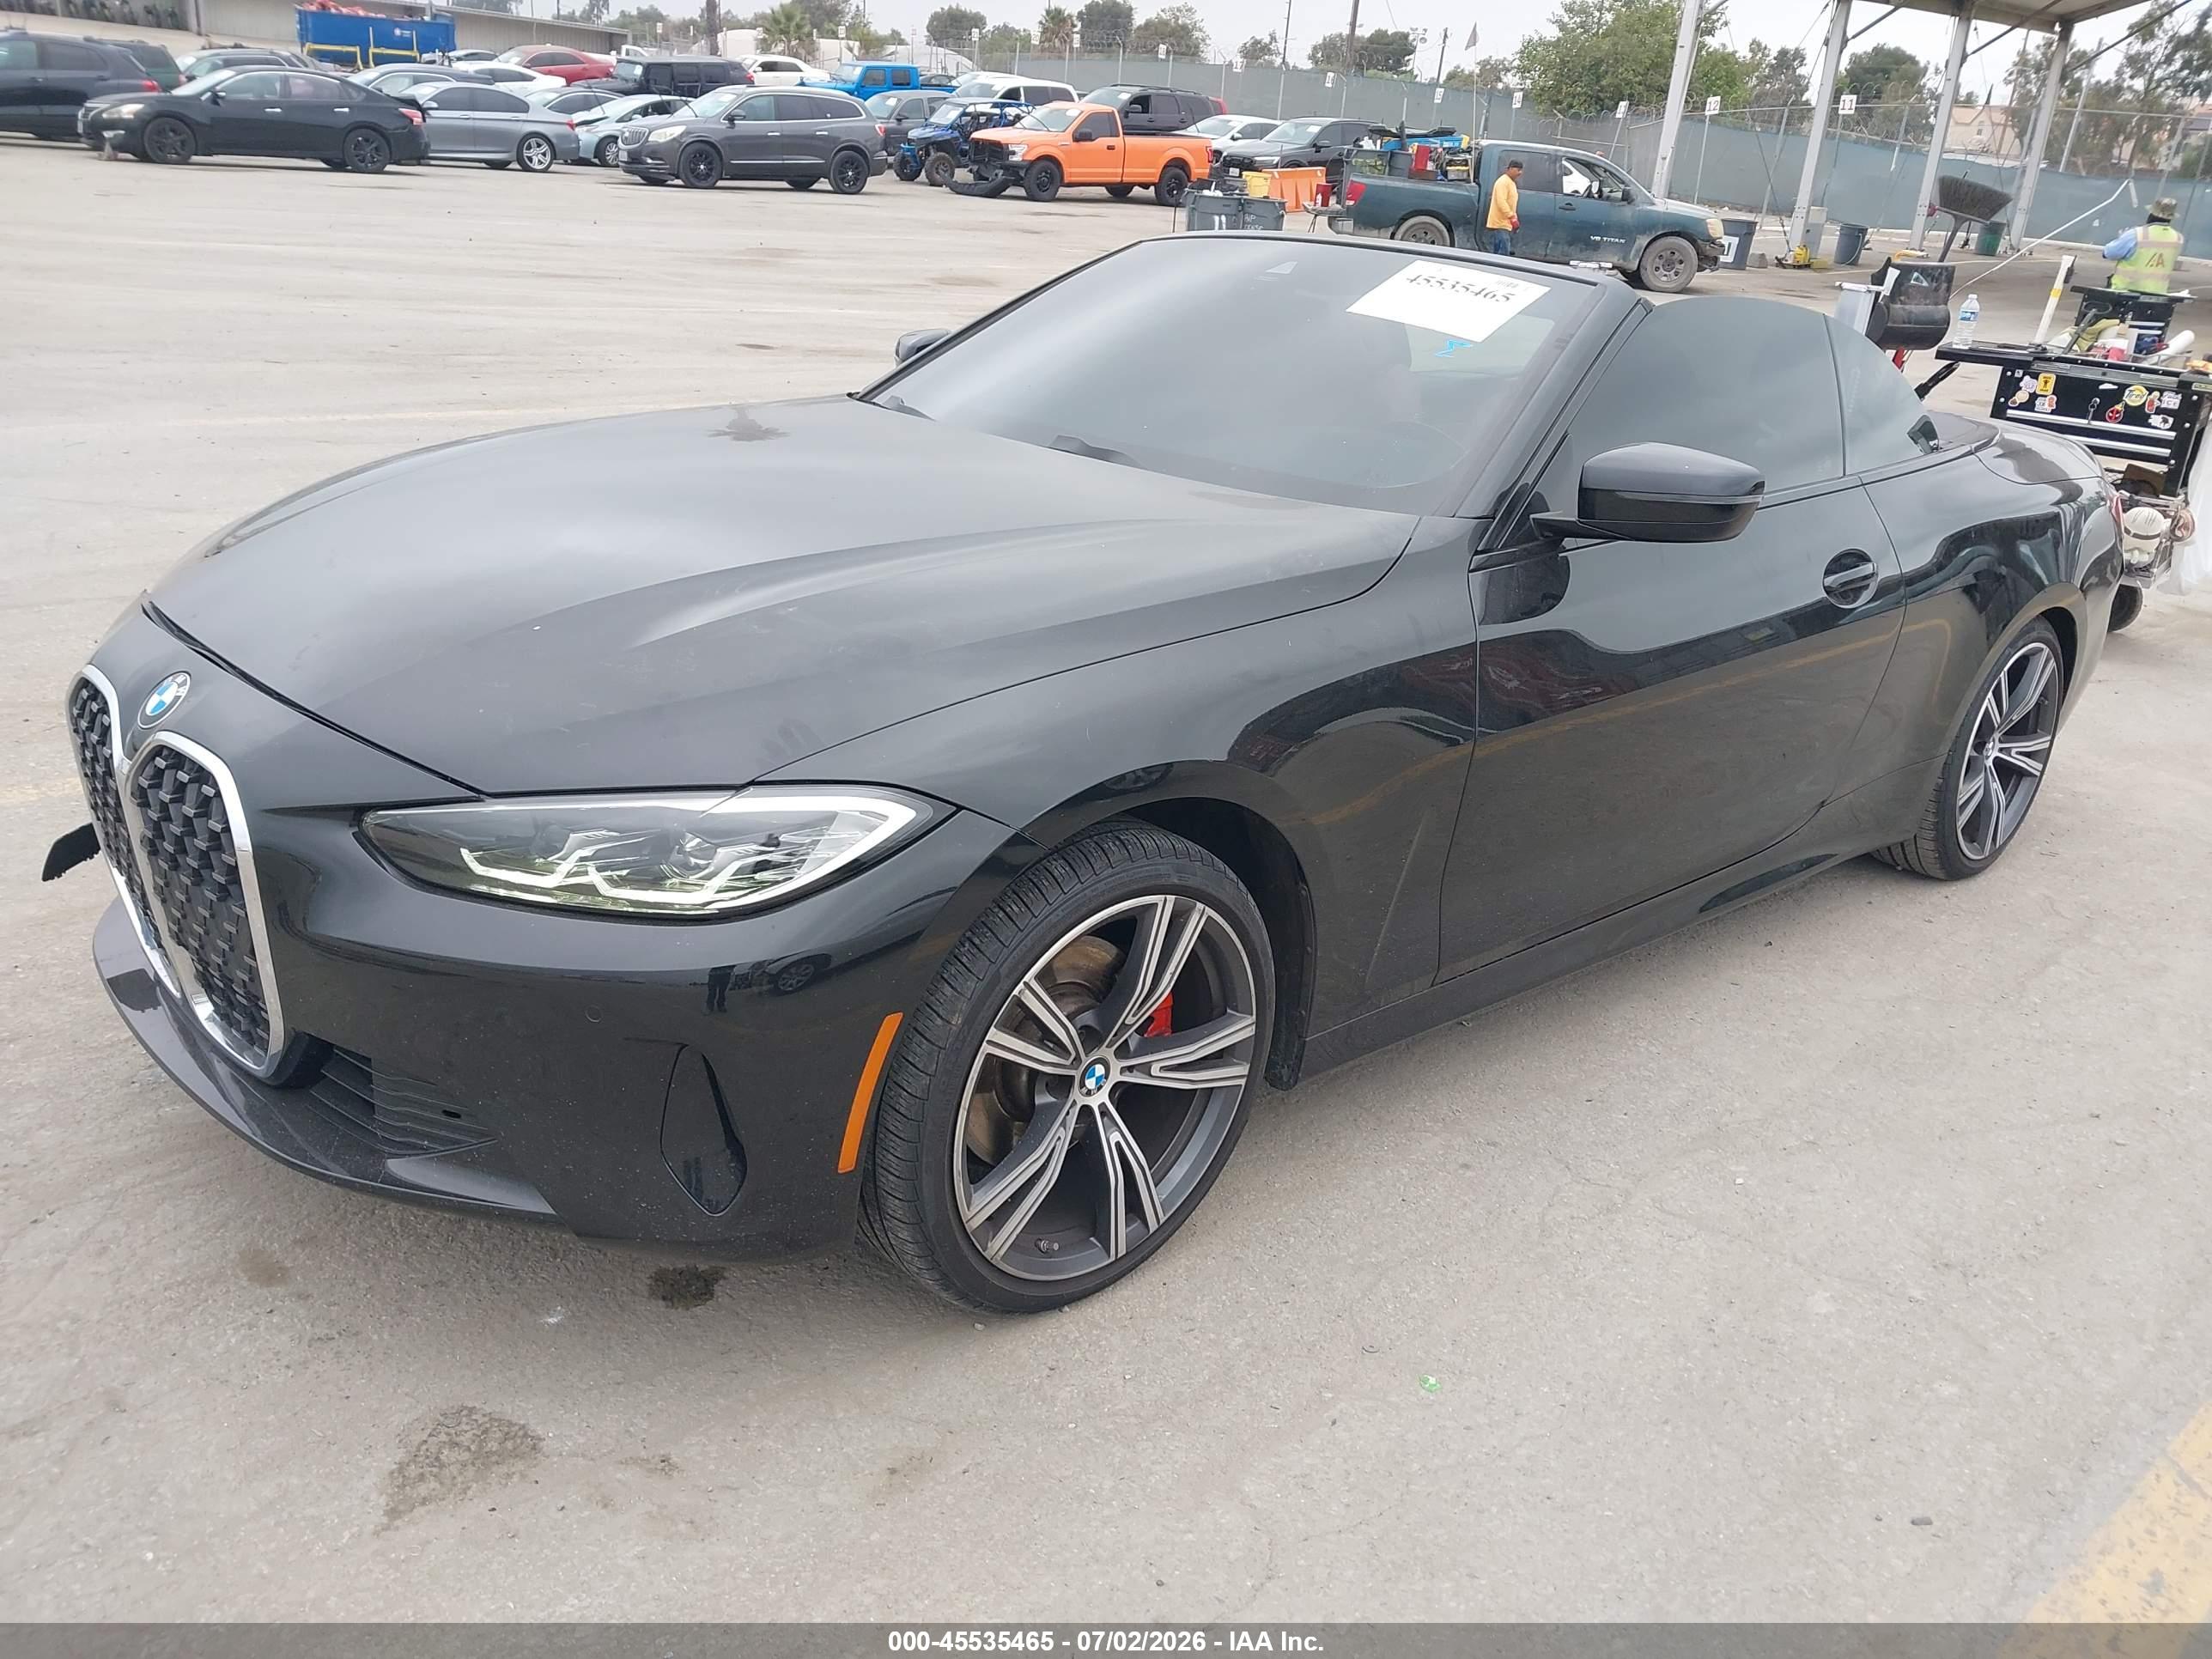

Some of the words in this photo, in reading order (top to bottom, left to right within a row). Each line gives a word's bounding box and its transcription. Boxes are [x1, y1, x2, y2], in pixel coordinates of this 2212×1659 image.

[1706, 100, 1719, 112] 12
[1839, 98, 1855, 112] 11
[1406, 274, 1516, 302] 45535465
[2124, 389, 2148, 399] Tired
